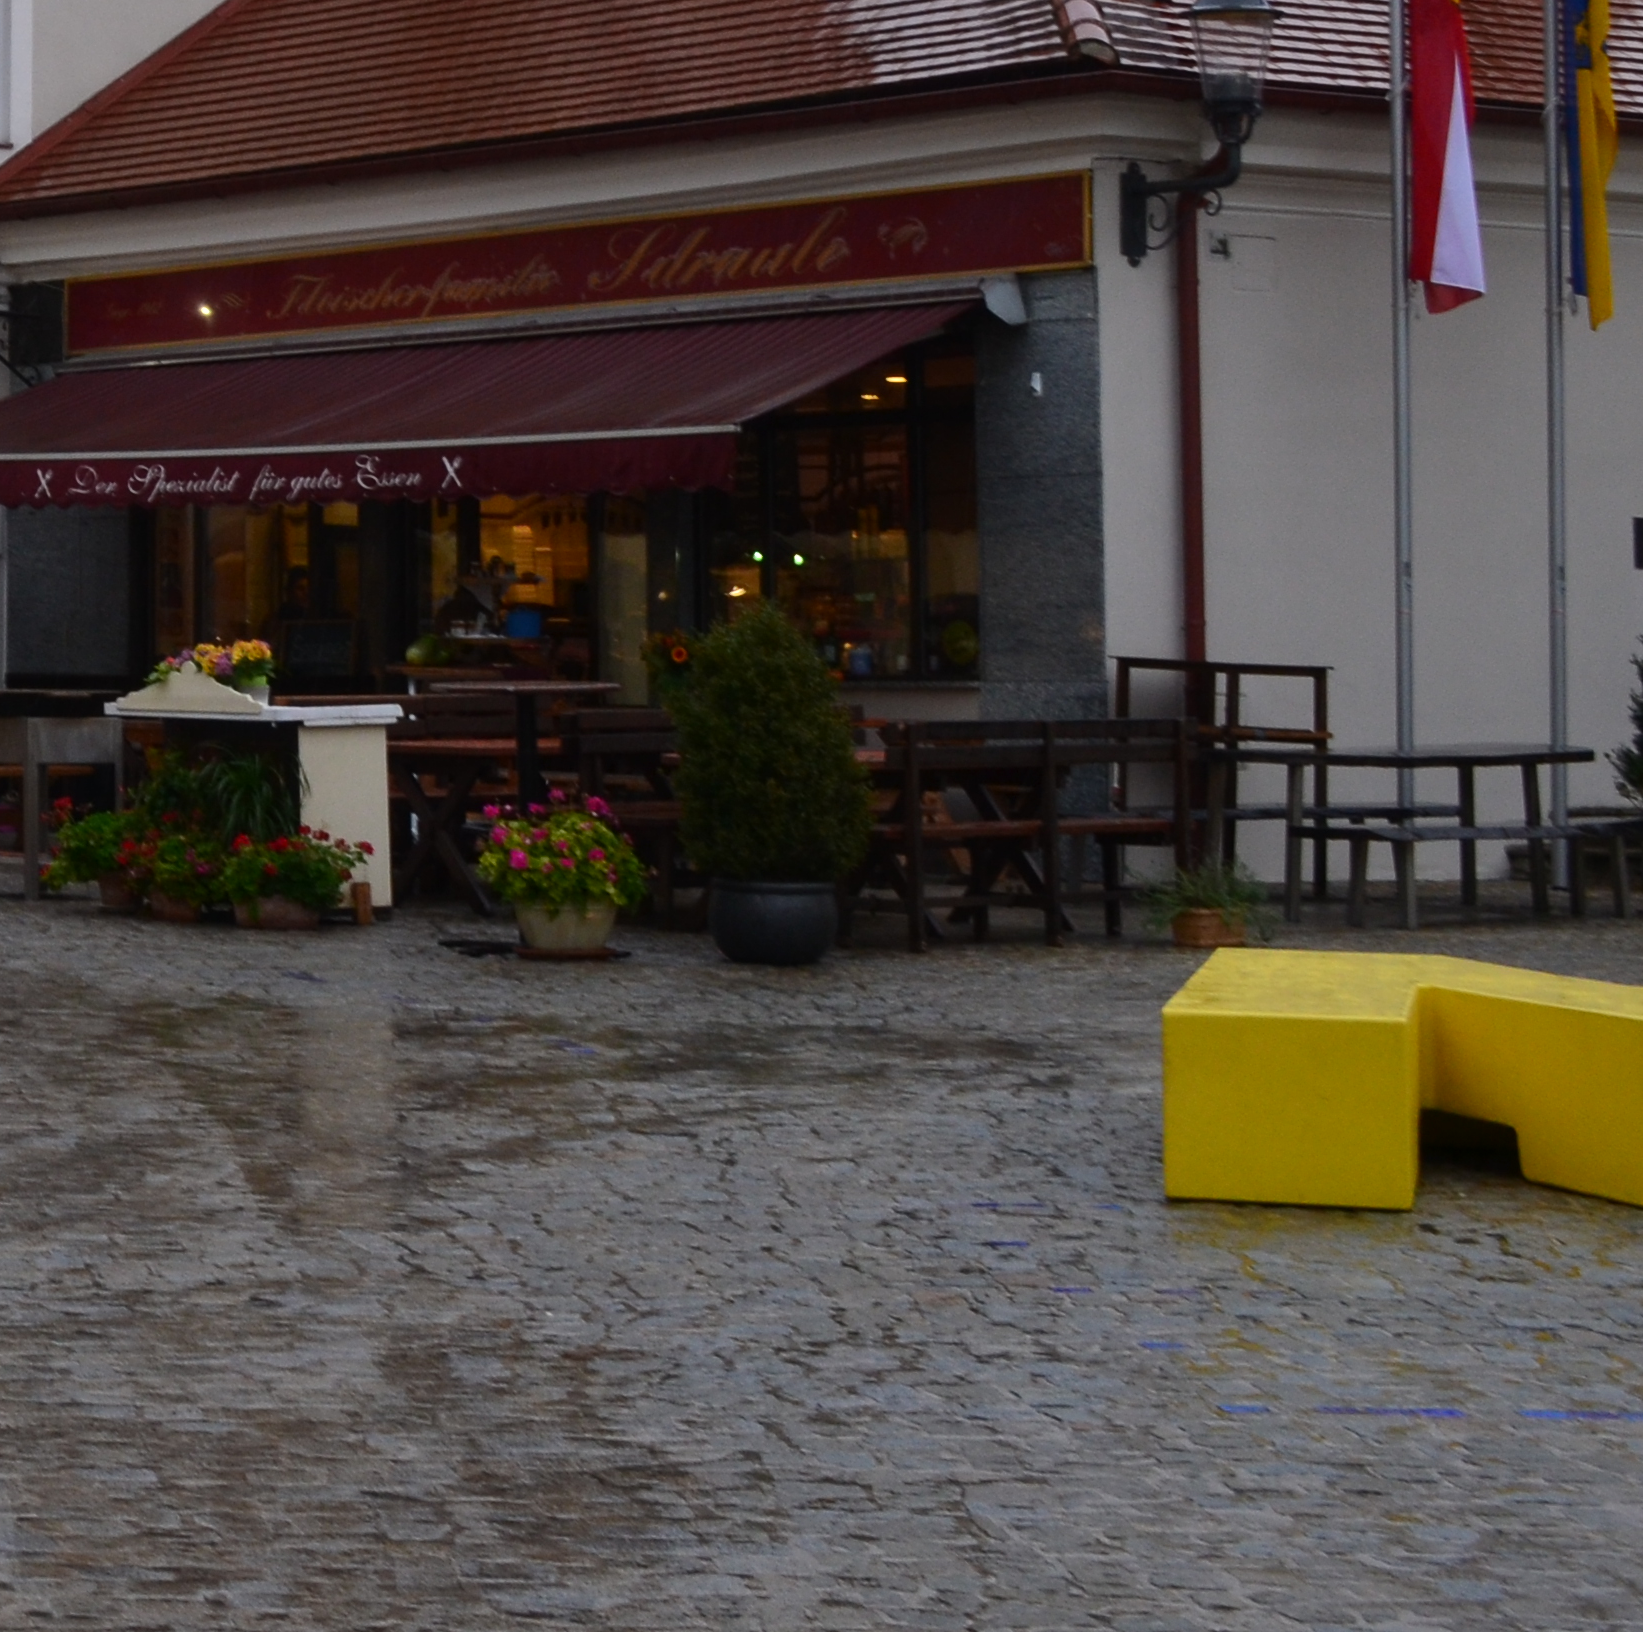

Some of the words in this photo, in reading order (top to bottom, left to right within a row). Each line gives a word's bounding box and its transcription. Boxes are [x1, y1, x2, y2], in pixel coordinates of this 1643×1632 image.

[67, 464, 117, 495] Der
[127, 464, 240, 503] Spezialist
[249, 464, 286, 501] für
[286, 467, 343, 501] gutes
[353, 454, 423, 490] Essen
